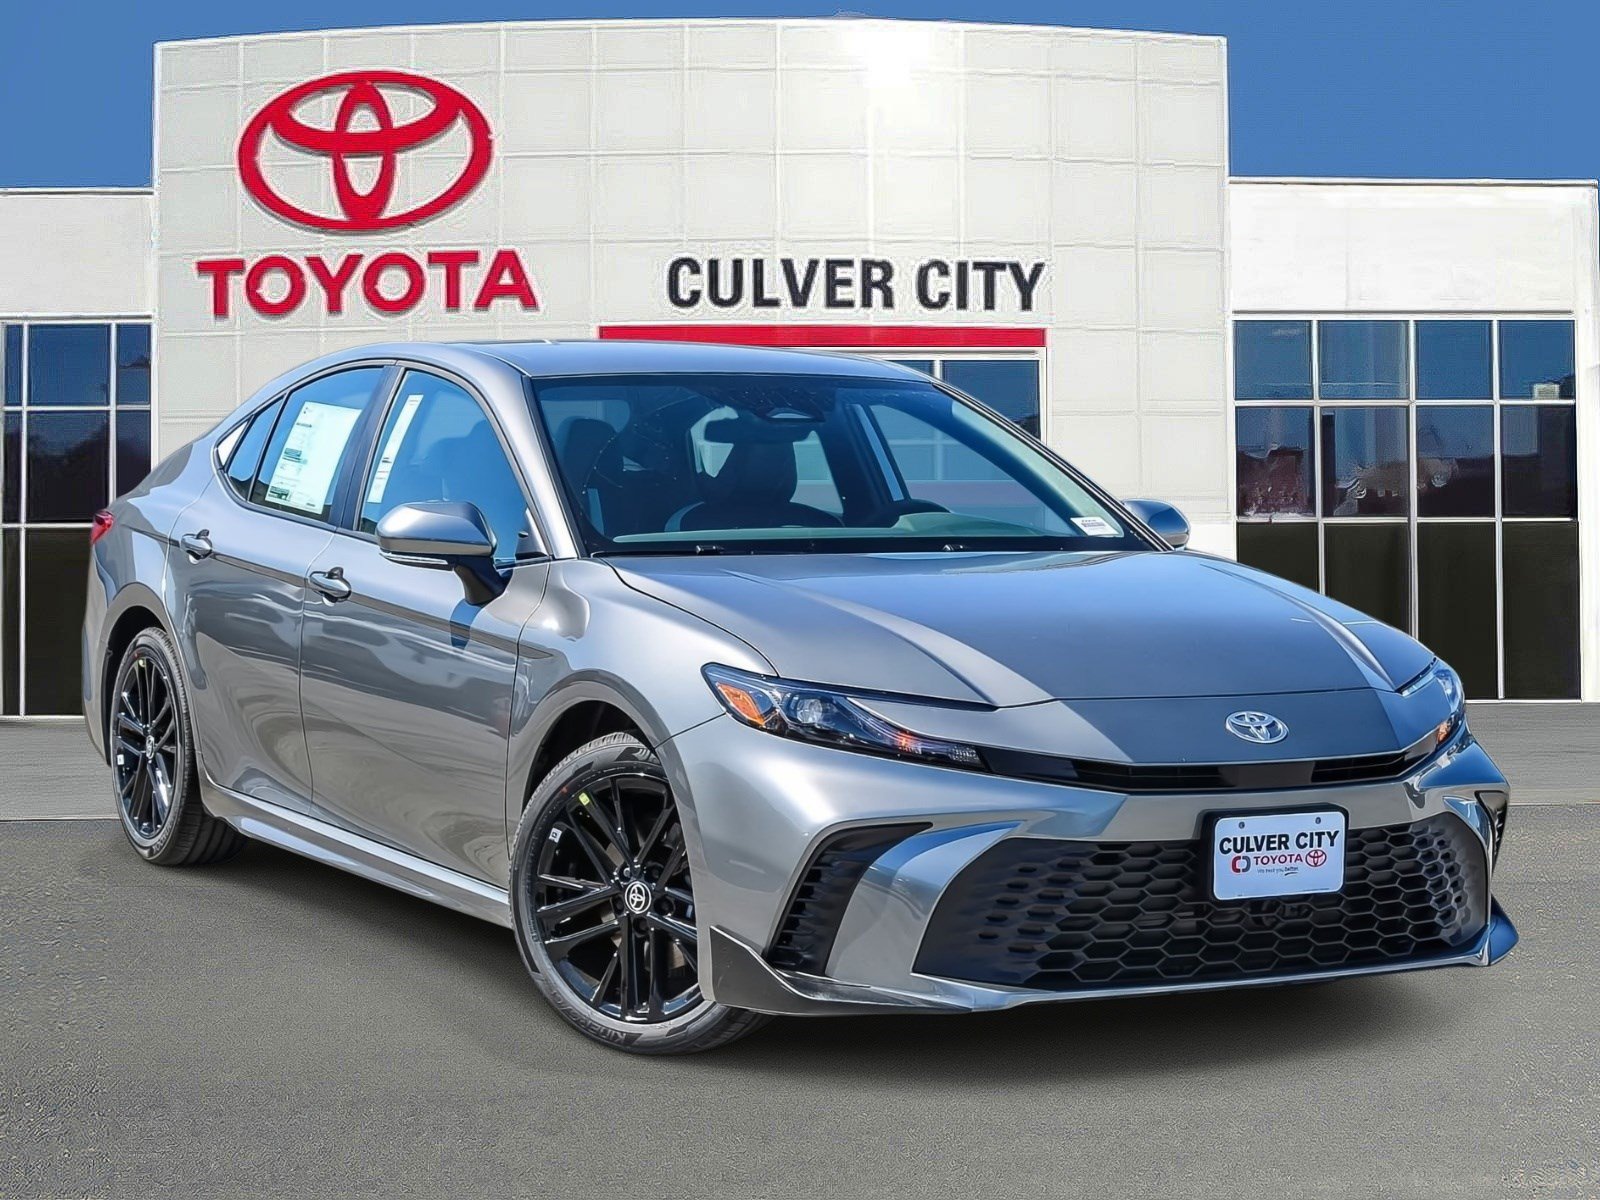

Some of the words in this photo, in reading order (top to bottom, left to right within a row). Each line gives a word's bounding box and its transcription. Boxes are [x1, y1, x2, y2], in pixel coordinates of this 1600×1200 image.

[195, 250, 540, 318] TOYOTA
[667, 257, 896, 309] CULVER
[915, 259, 1046, 311] CITY
[1219, 834, 1290, 855] CULVER
[1295, 830, 1340, 849] CITY
[1253, 853, 1304, 866] TOYOTA
